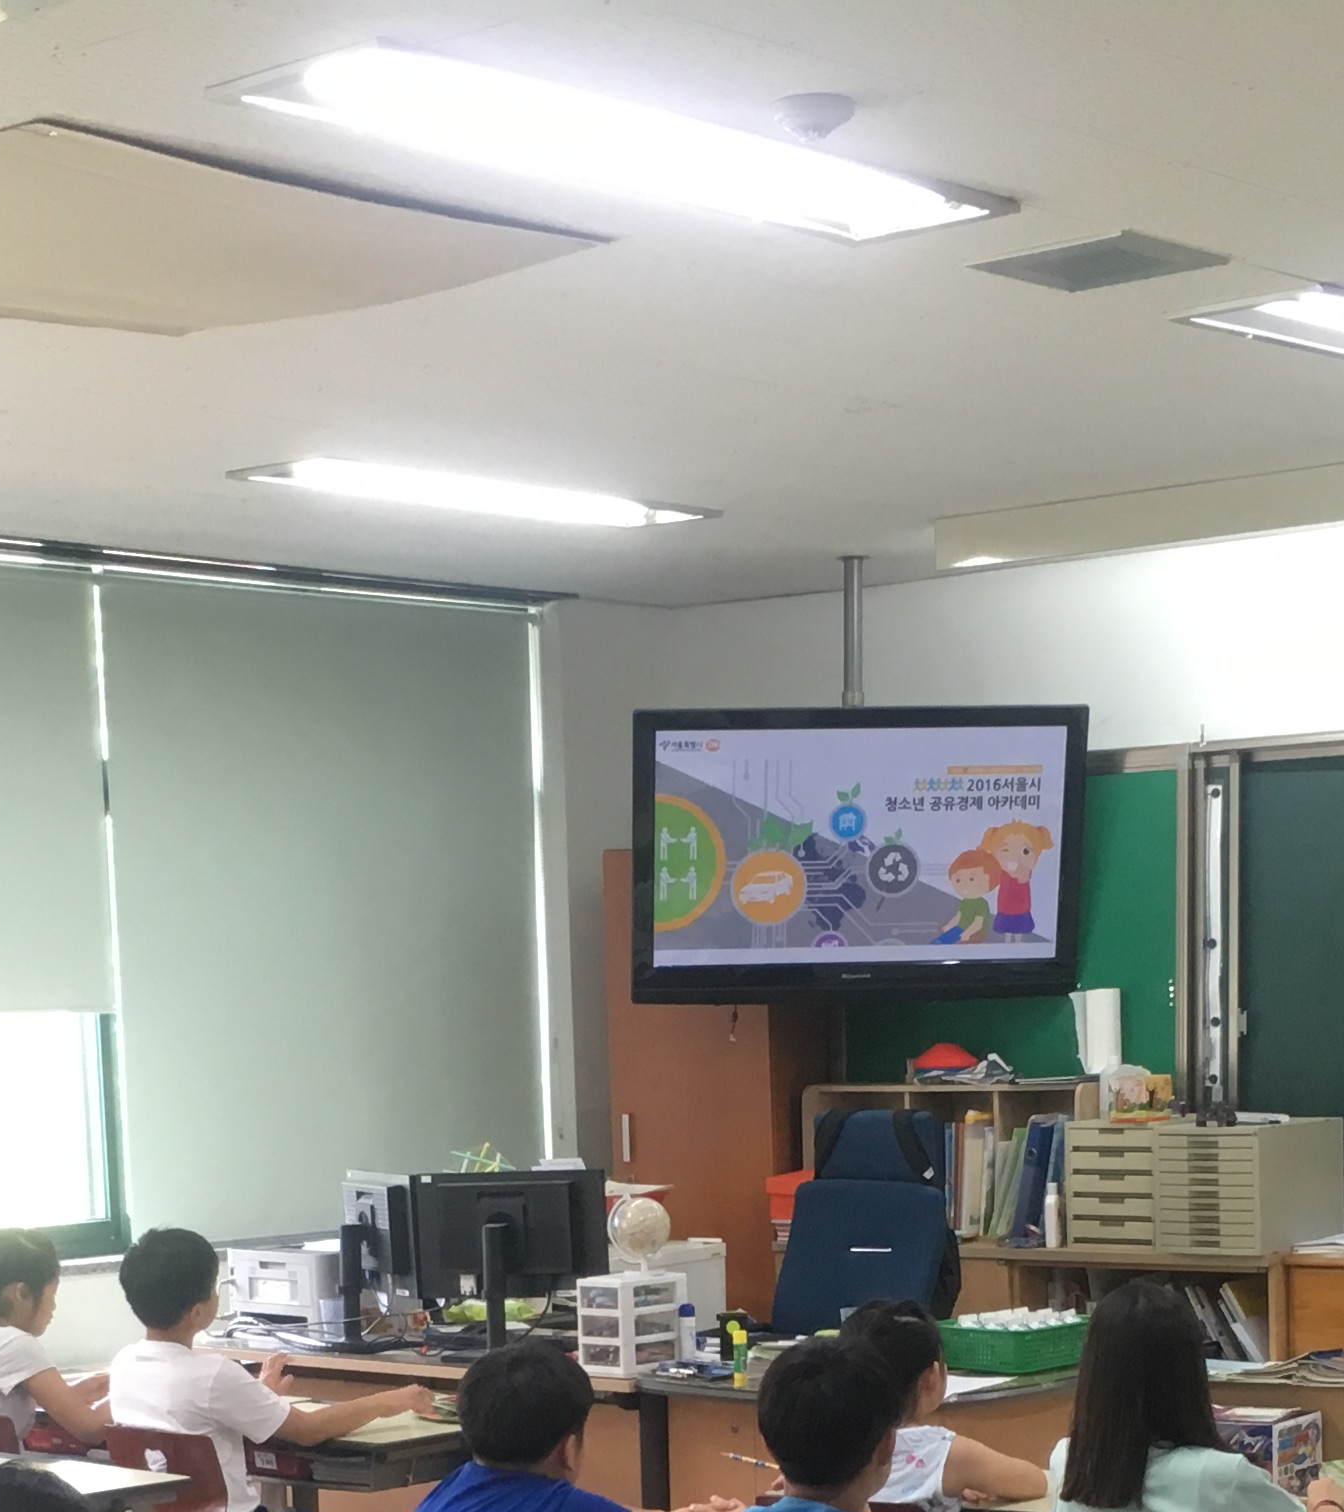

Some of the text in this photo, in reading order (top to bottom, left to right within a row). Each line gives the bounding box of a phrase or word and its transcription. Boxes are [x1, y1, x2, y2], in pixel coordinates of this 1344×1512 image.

[966, 777, 1042, 792] 2016서울시
[885, 794, 1041, 812] 청소년 공유경제 아카데미
